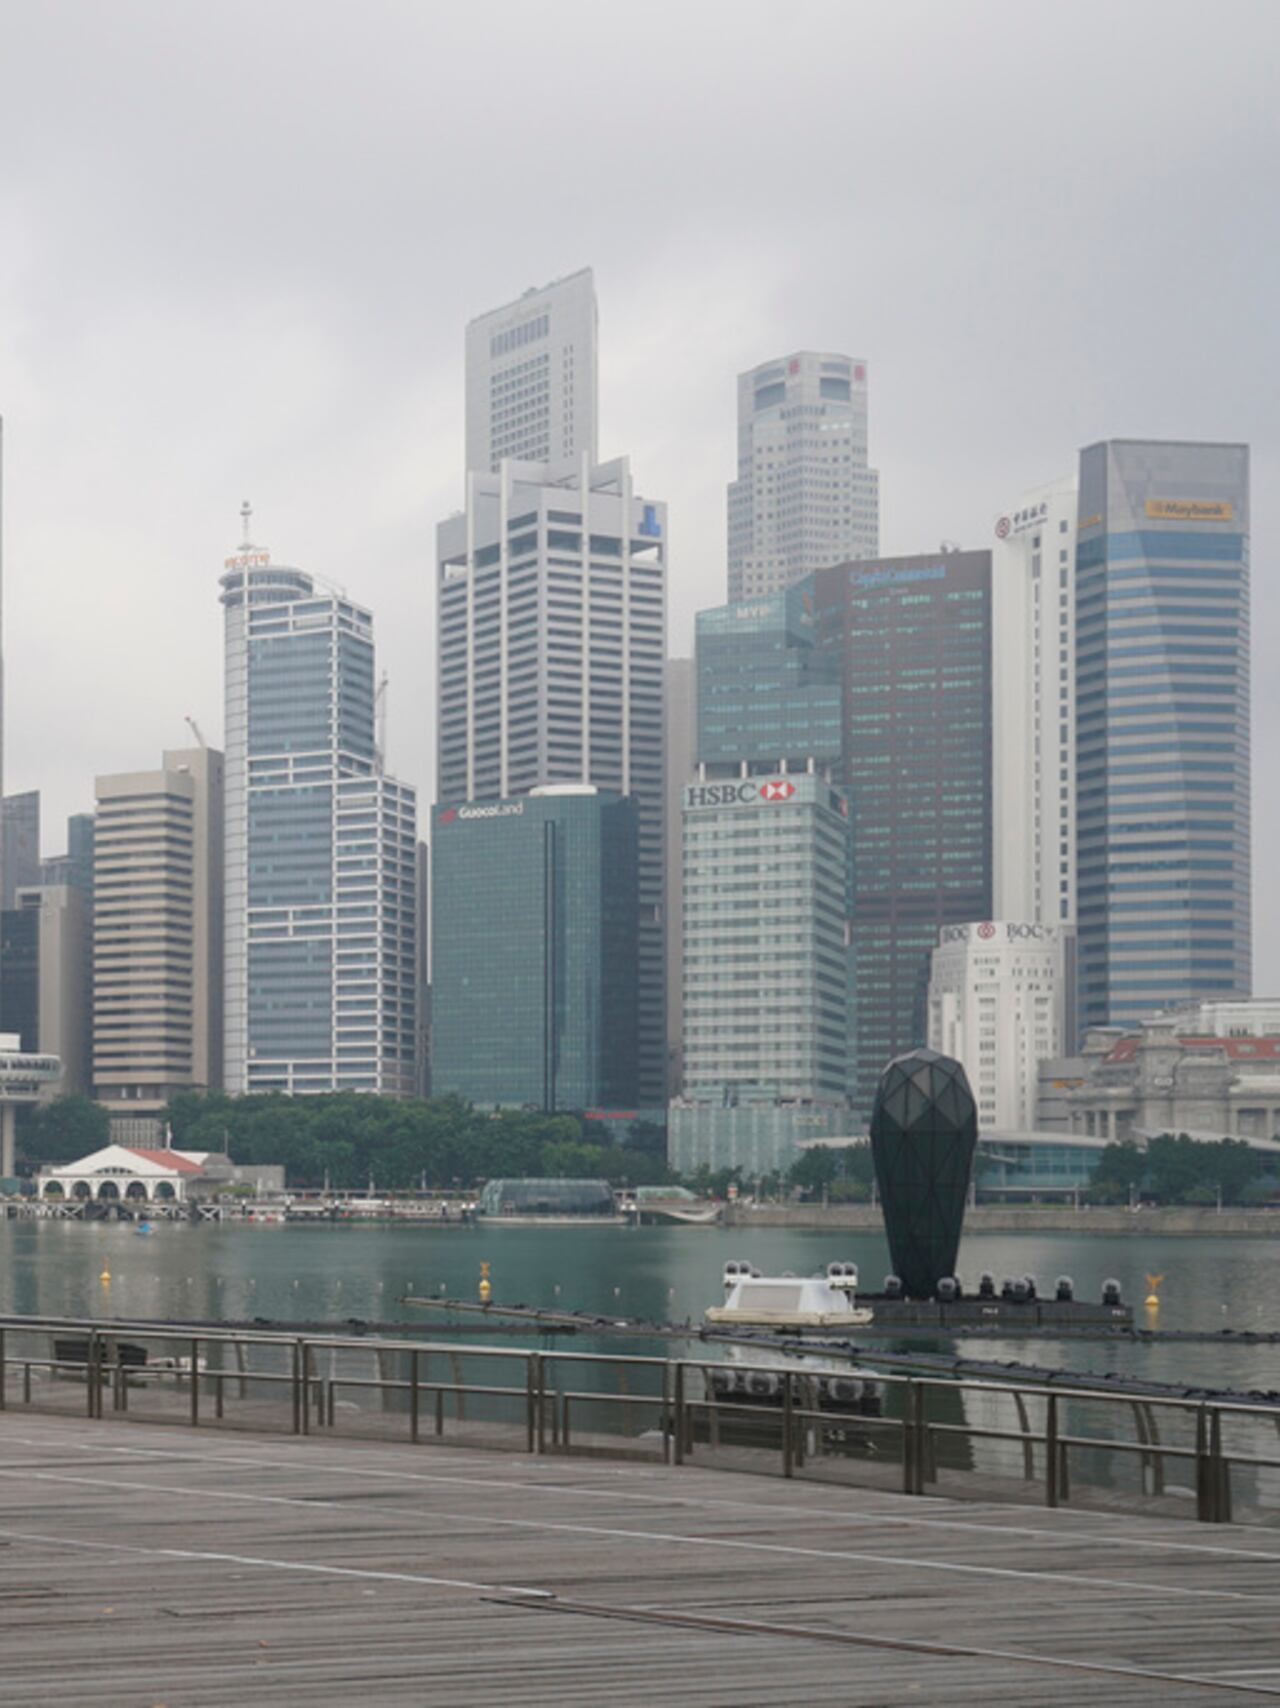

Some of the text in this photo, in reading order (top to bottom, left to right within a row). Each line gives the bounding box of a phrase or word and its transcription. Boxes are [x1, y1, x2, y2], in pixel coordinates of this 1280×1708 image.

[1166, 502, 1222, 517] Maybank
[688, 782, 757, 806] HSBC
[458, 800, 523, 818] GuocoLand
[1007, 923, 1043, 939] BOC
